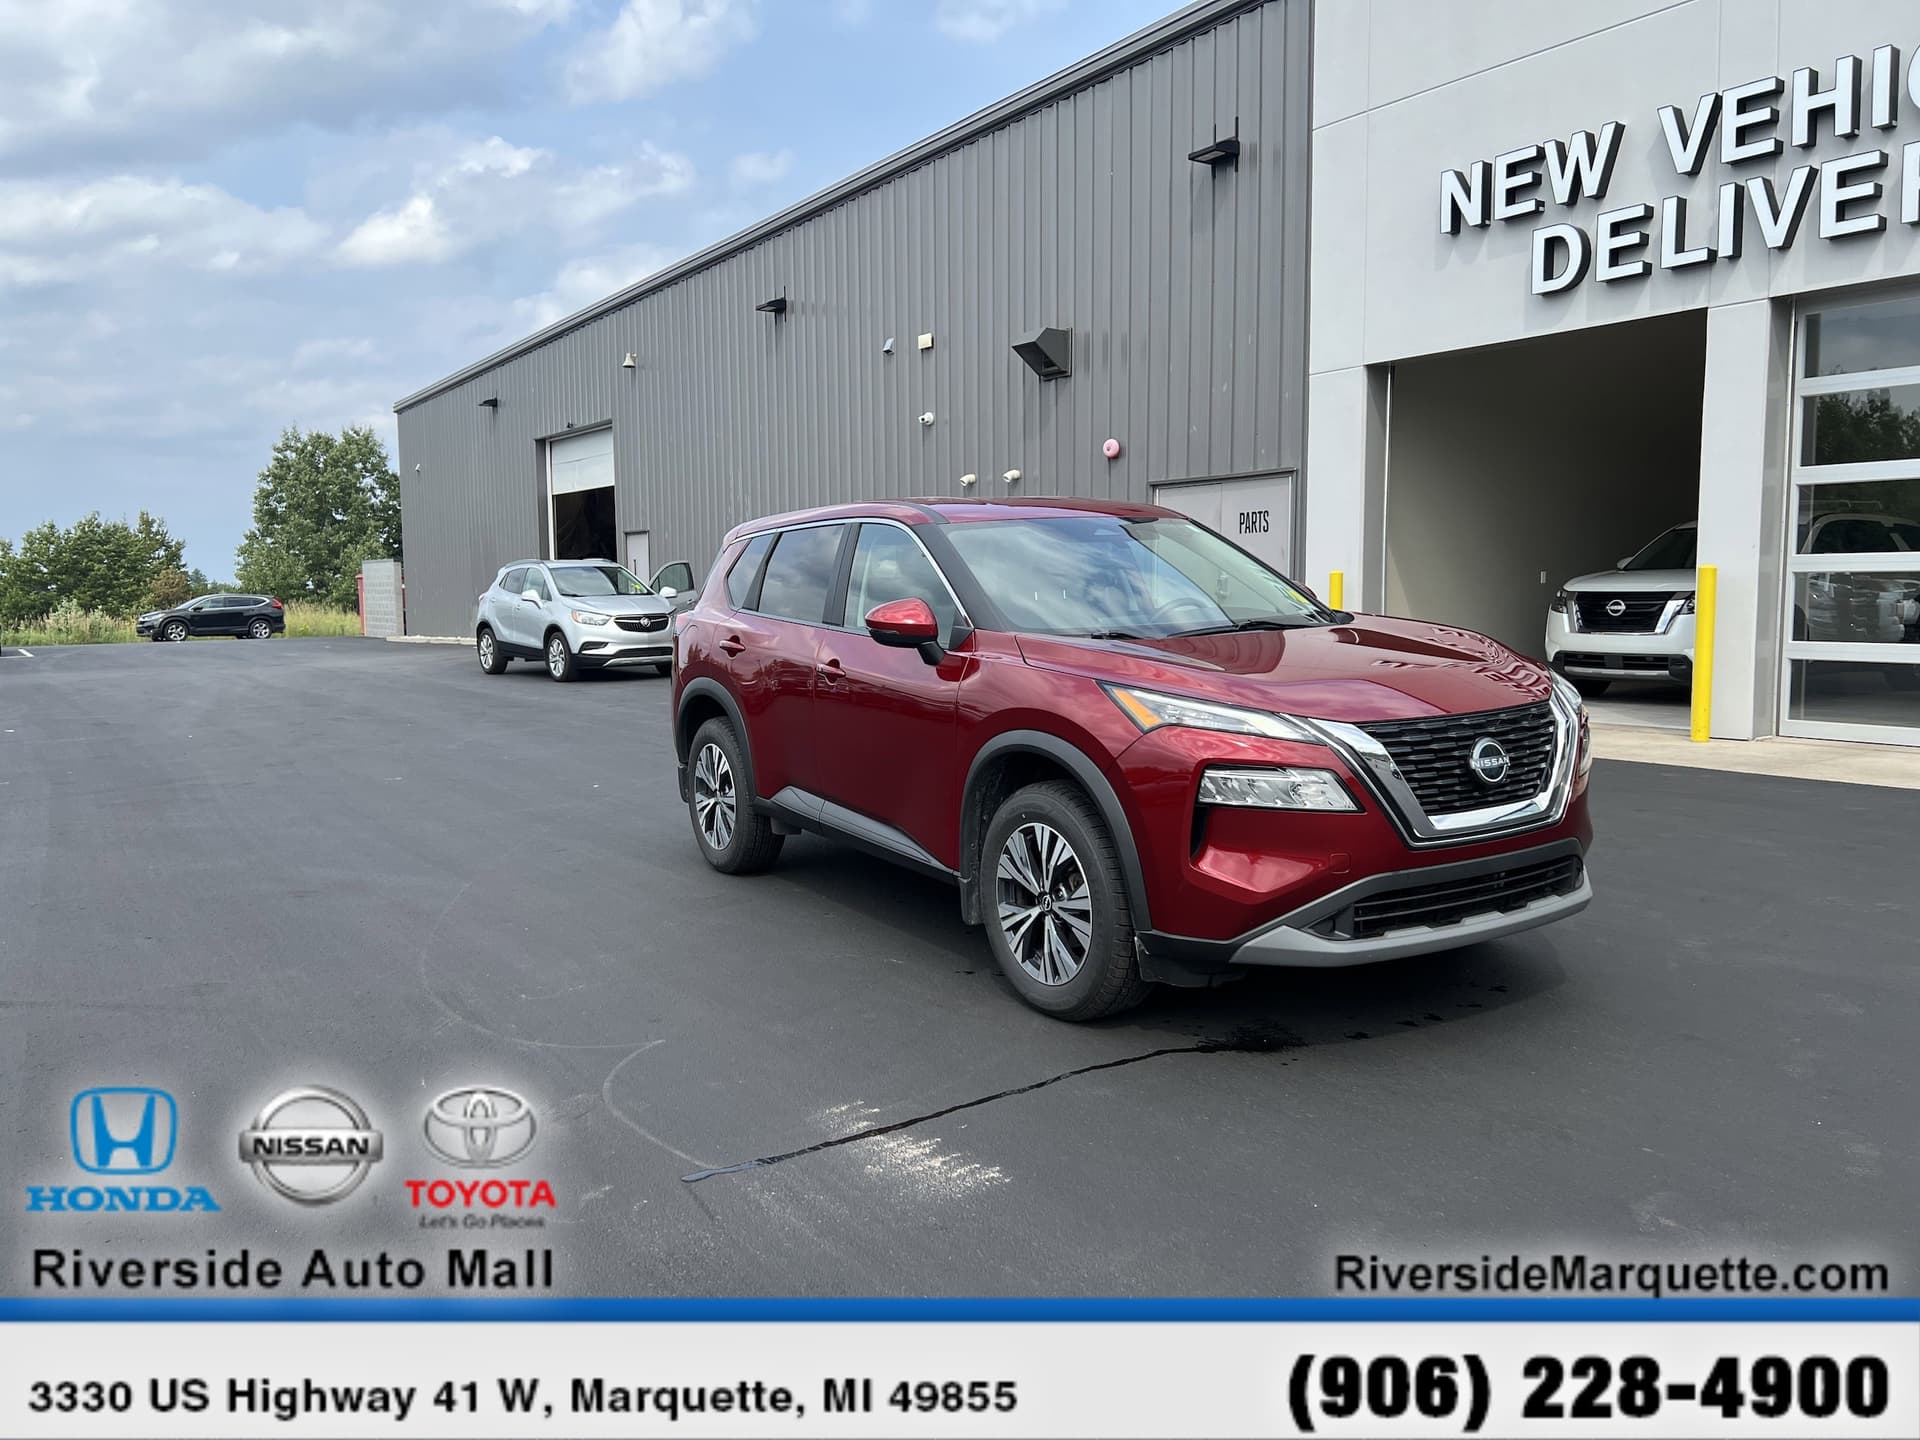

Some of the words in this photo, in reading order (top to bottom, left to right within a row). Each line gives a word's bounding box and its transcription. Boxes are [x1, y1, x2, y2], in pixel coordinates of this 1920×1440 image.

[1440, 121, 1625, 234] NEW
[1657, 44, 1920, 175] VEHI
[1239, 510, 1270, 534] PARTS
[1472, 755, 1511, 768] NISSAN
